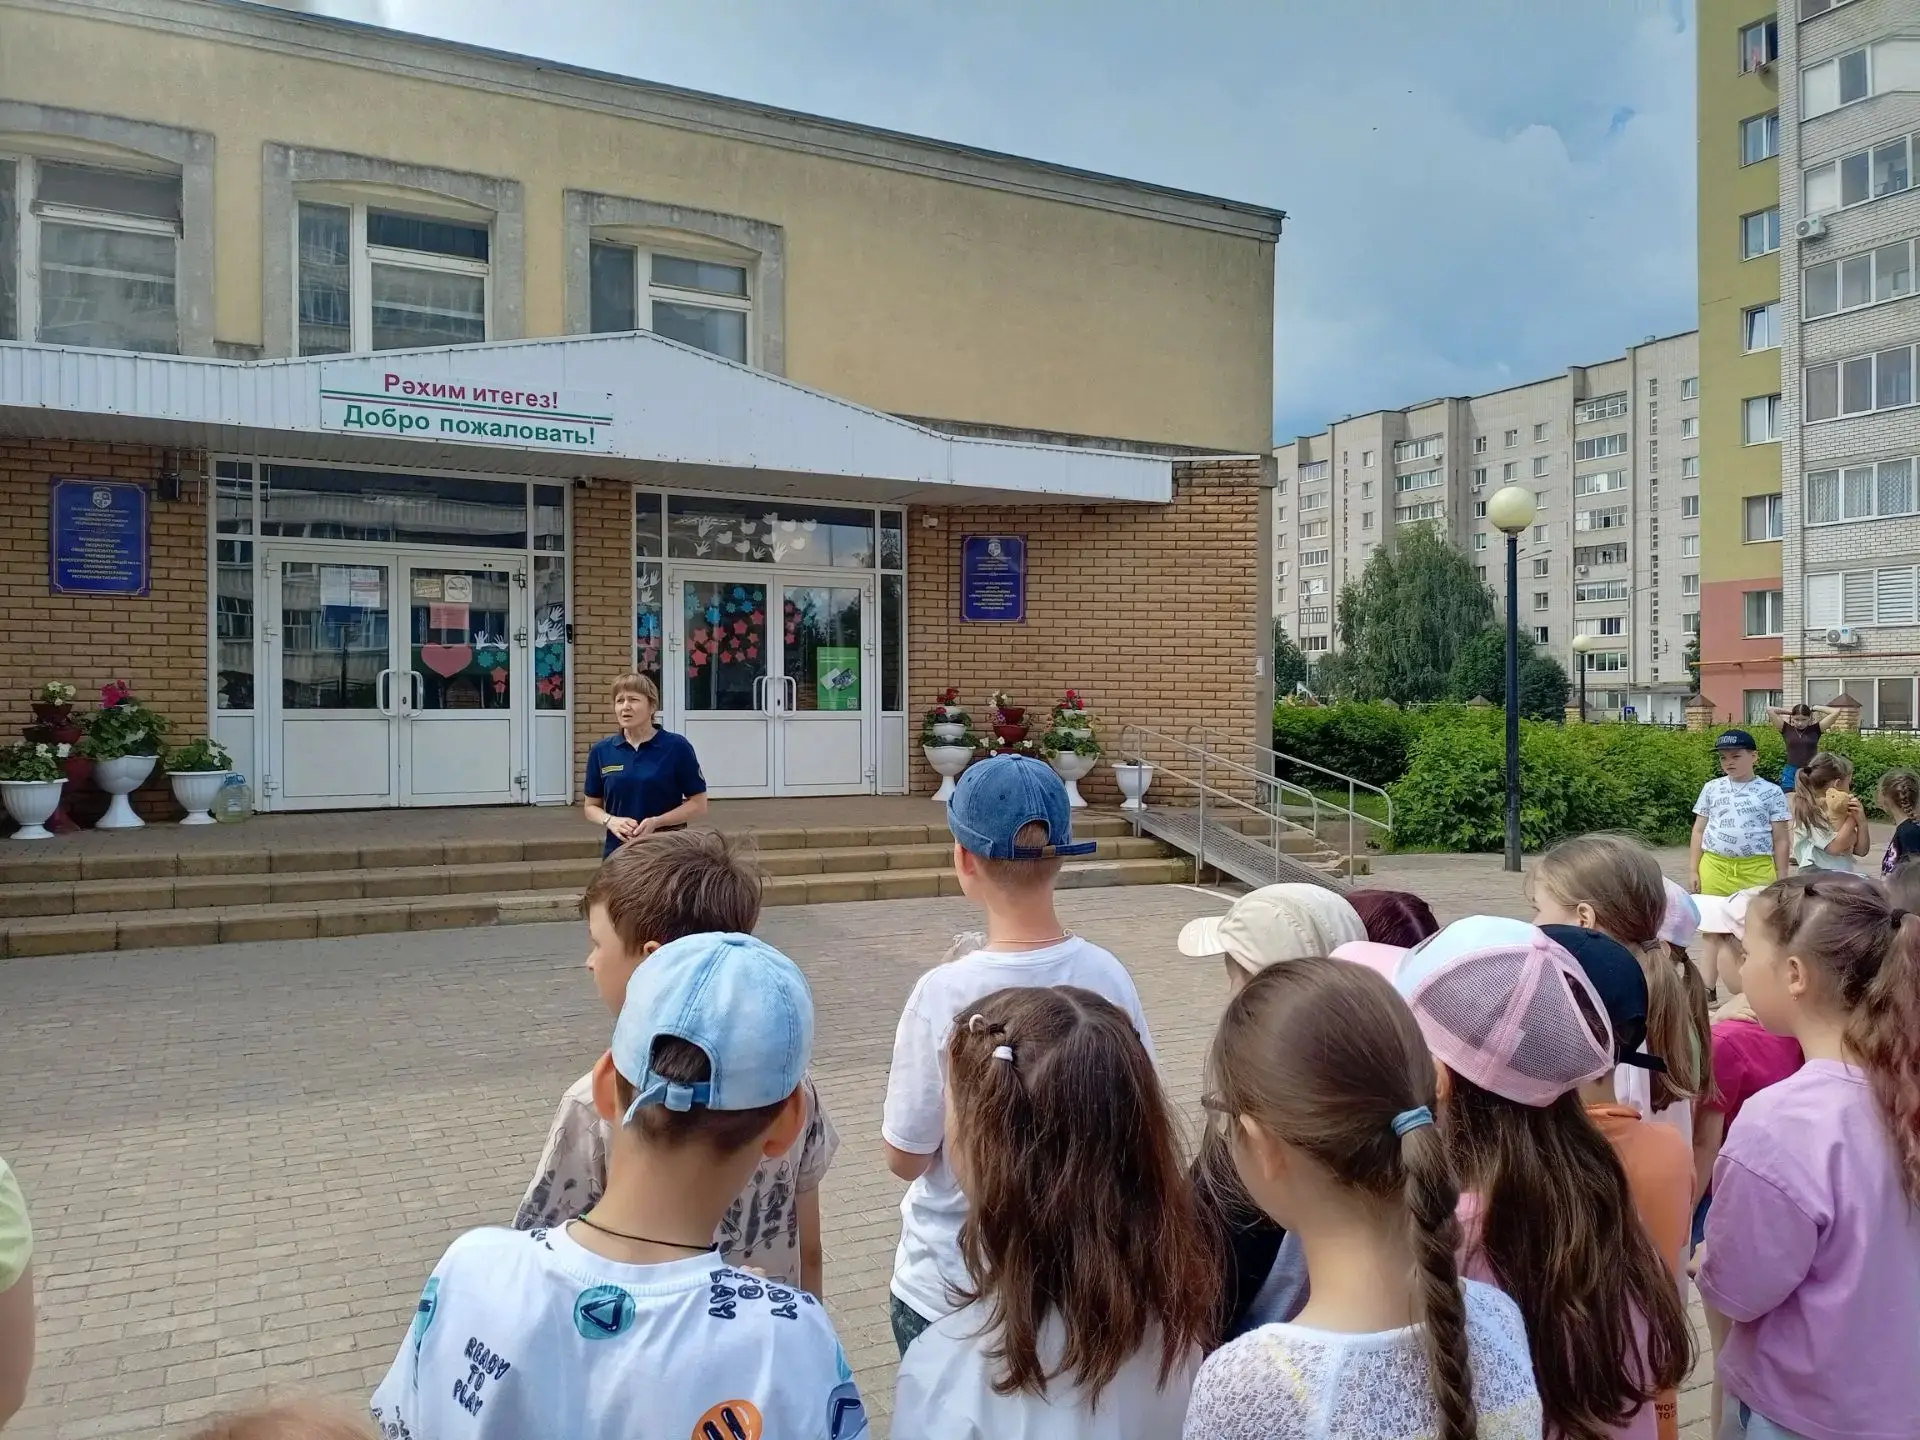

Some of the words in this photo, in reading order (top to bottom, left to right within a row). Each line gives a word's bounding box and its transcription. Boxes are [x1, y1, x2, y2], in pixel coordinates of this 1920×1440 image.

[384, 374, 465, 400] Рәхим
[473, 387, 559, 409] итегез!
[344, 404, 430, 433] Добро
[440, 417, 595, 446] пожаловать!
[464, 1336, 511, 1380] READY
[467, 1363, 485, 1392] TO
[452, 1378, 483, 1417] PLAY
